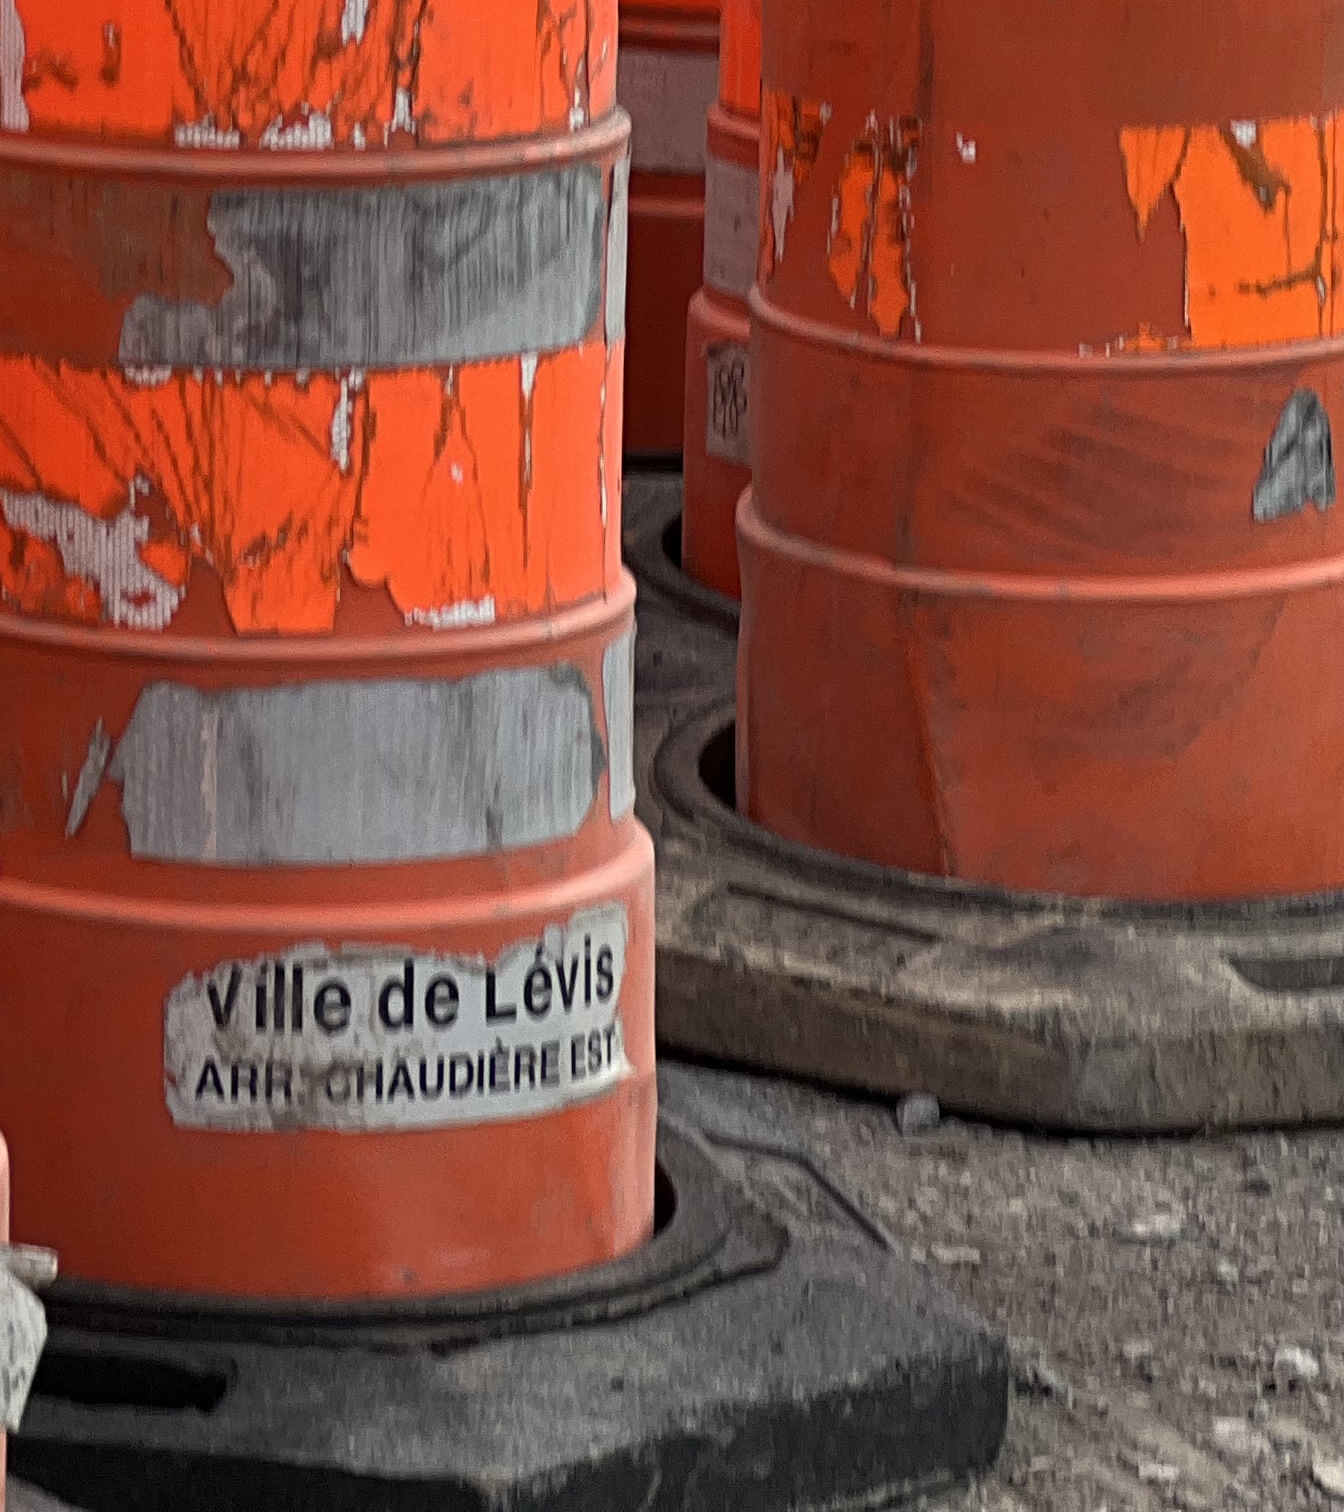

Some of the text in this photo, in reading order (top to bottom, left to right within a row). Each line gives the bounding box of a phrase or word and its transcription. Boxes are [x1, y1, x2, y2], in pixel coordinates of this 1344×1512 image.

[207, 933, 614, 1035] Ville de Lévis
[570, 1021, 615, 1081] EST
